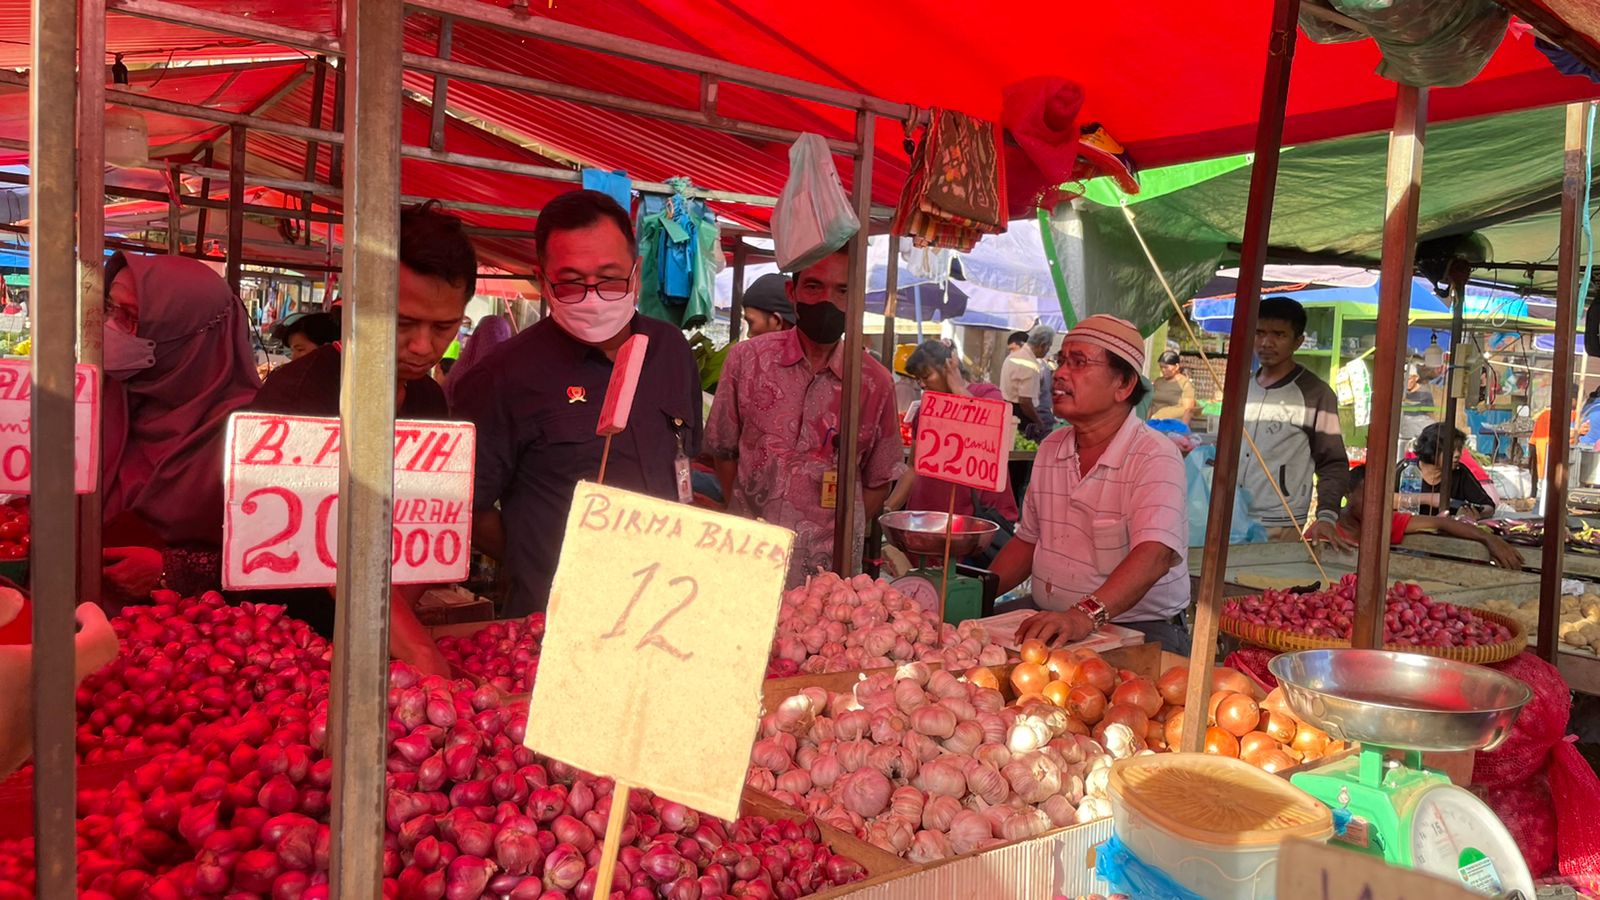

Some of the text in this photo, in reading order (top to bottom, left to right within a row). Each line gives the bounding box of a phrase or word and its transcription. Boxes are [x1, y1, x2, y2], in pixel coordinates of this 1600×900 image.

[313, 425, 462, 472] PTIH
[393, 498, 463, 524] URAH
[579, 493, 683, 539] BIRMA
[600, 562, 699, 661] 12
